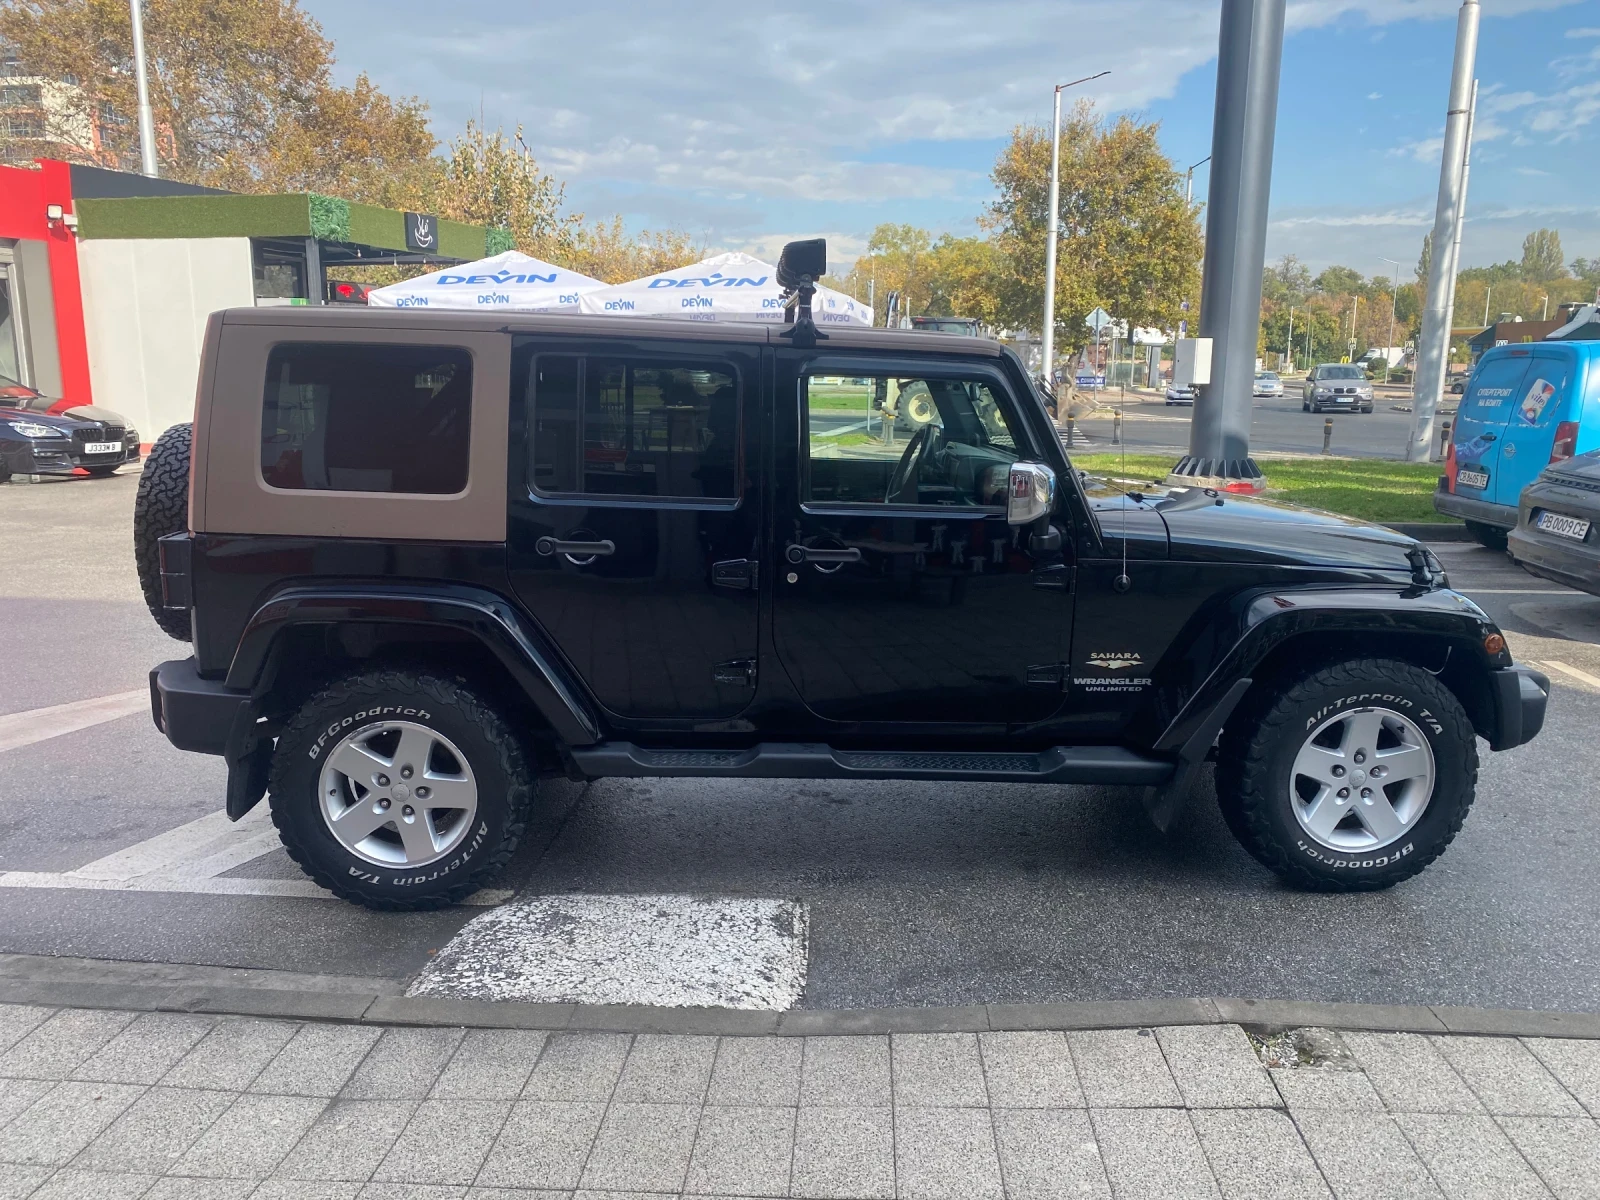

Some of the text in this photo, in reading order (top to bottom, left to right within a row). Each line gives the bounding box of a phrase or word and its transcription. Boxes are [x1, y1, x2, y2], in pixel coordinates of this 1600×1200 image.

[437, 272, 557, 285] DEVIN
[648, 276, 768, 288] DEVIN
[396, 297, 428, 307] DEVIN
[477, 295, 510, 304] DEVIN
[559, 295, 580, 304] DEV
[681, 298, 713, 307] DEVIN
[762, 299, 787, 308] DEV
[604, 301, 635, 310] DEVIN
[1073, 678, 1152, 686] WRANGLER
[1305, 693, 1413, 730] All-Terrain
[308, 706, 431, 760] BFGoodrich
[348, 821, 488, 886] All-Terrain T/A
[1297, 840, 1414, 869] BFGoodrich
